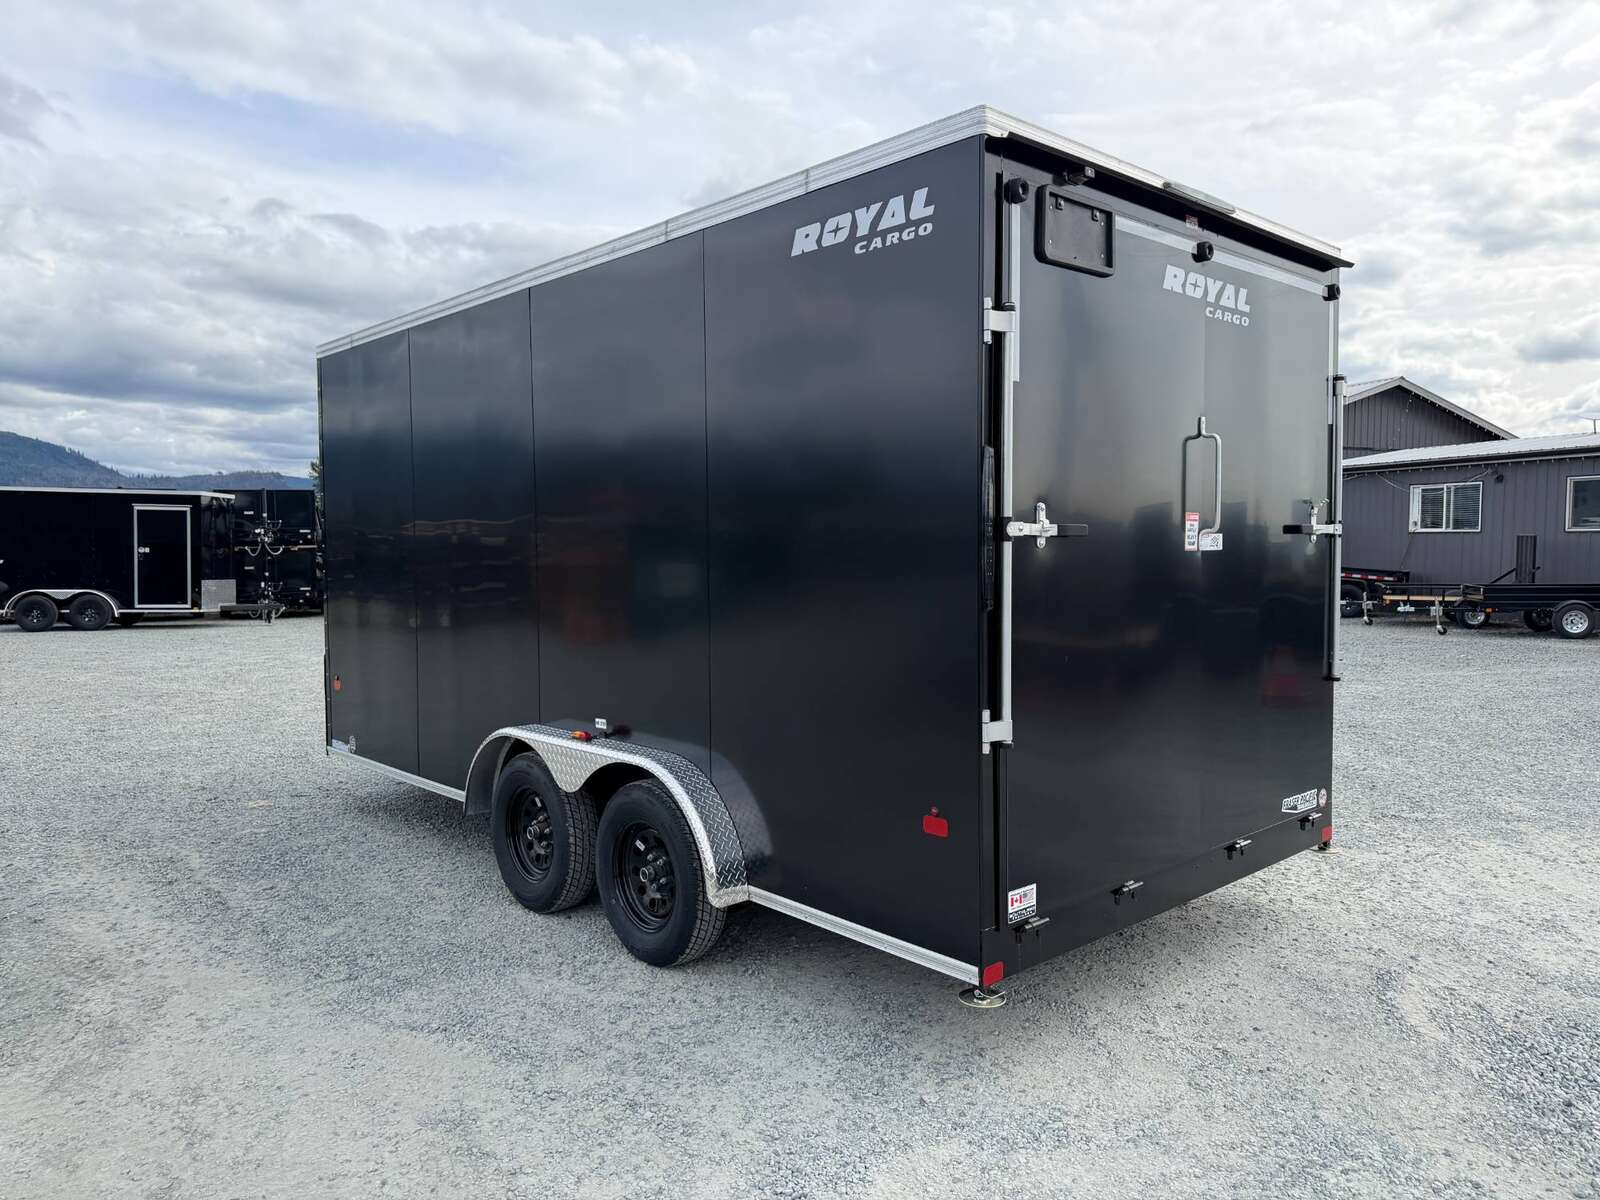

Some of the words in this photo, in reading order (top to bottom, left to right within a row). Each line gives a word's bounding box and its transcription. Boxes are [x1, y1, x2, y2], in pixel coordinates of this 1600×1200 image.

[791, 187, 935, 257] ROYAL
[854, 223, 933, 254] CARGO
[1163, 264, 1250, 312] ROYAL
[1205, 306, 1249, 326] CARGO
